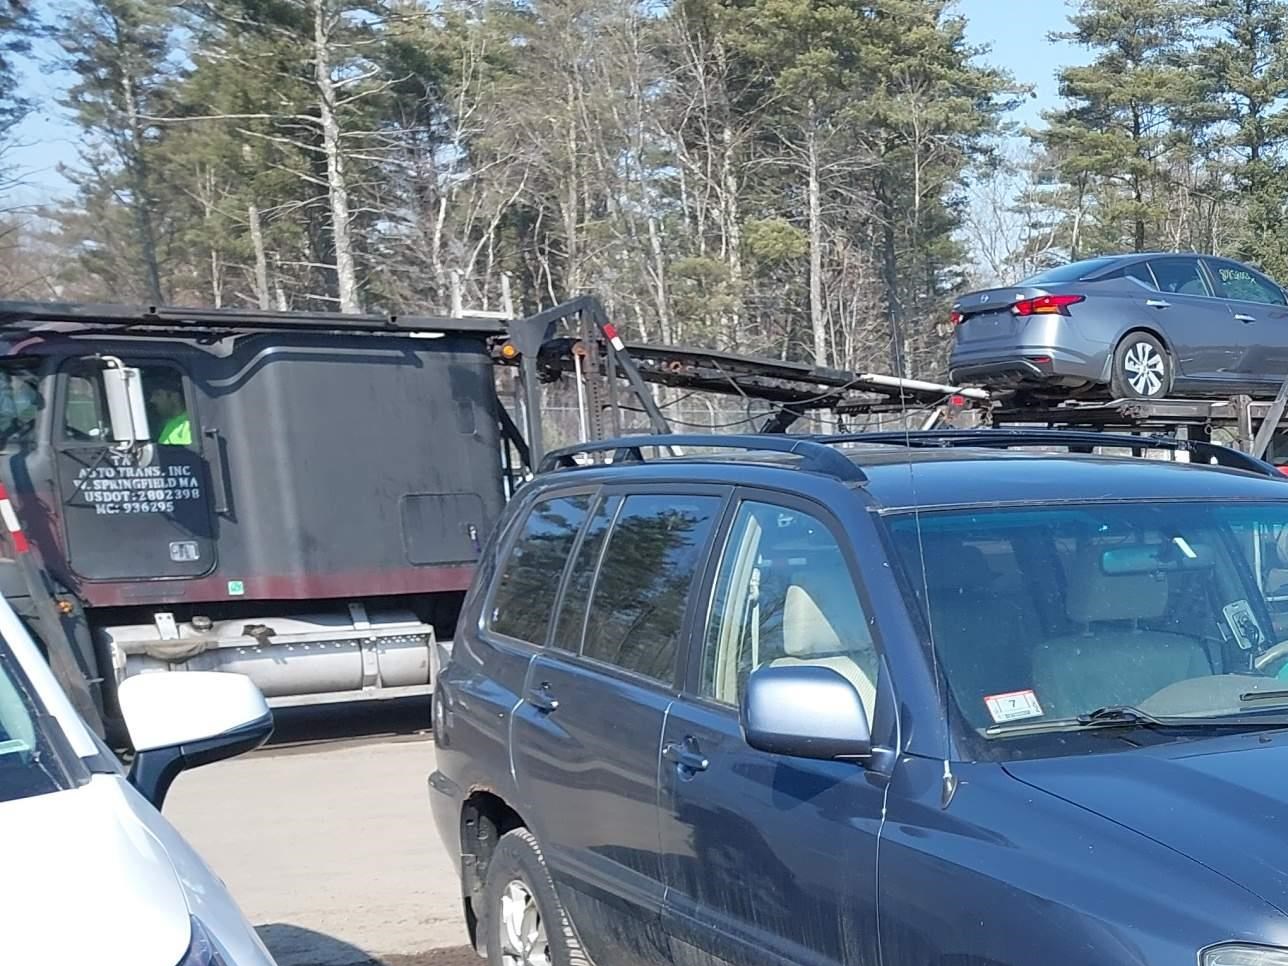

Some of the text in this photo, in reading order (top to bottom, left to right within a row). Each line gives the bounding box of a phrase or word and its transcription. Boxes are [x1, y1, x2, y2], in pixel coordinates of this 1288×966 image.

[79, 467, 115, 479] AUTO
[168, 465, 191, 476] INC
[93, 477, 176, 490] SPRINGFIELD
[178, 477, 198, 488] MA
[95, 501, 175, 515] MC: 936295
